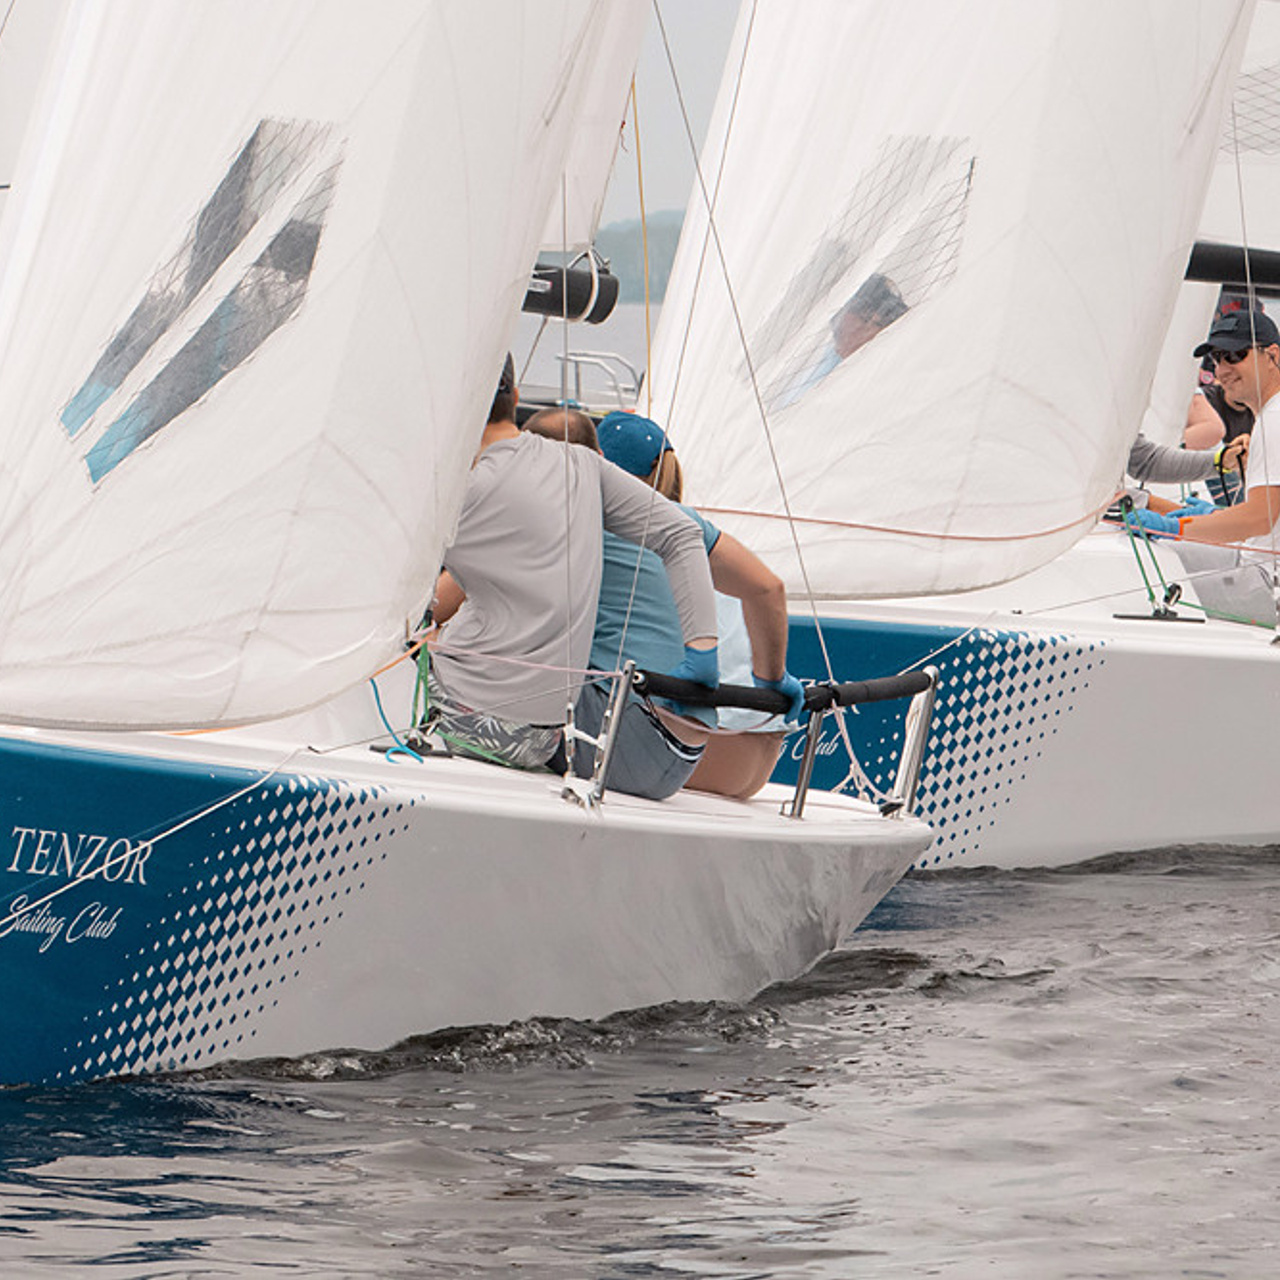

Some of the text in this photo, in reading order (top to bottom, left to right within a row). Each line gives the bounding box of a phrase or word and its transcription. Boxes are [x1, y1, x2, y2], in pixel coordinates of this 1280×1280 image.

[7, 826, 153, 885] TENZOR
[0, 893, 123, 953] Sailing Club
